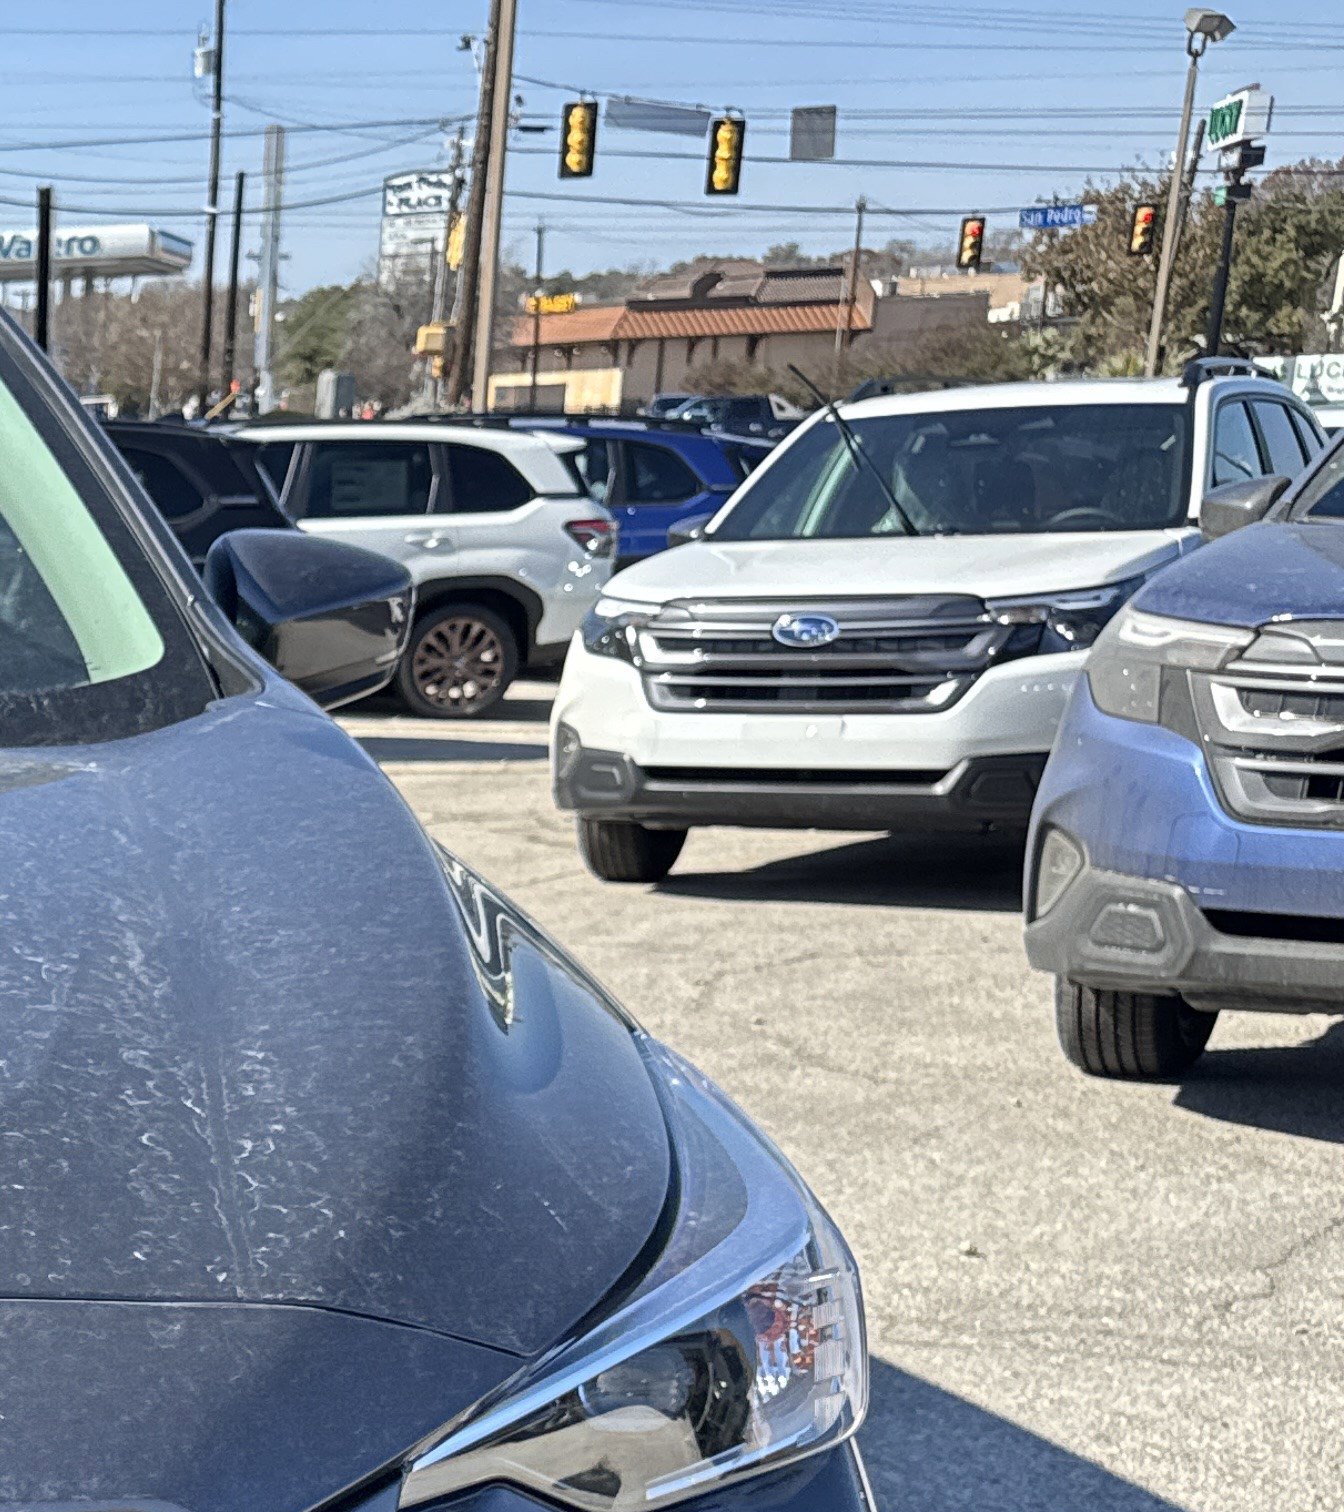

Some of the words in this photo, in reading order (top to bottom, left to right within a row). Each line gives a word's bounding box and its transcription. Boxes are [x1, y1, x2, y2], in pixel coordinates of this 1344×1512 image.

[1020, 209, 1044, 226] San
[1047, 207, 1082, 225] Pedro
[1297, 361, 1344, 380] LUC
